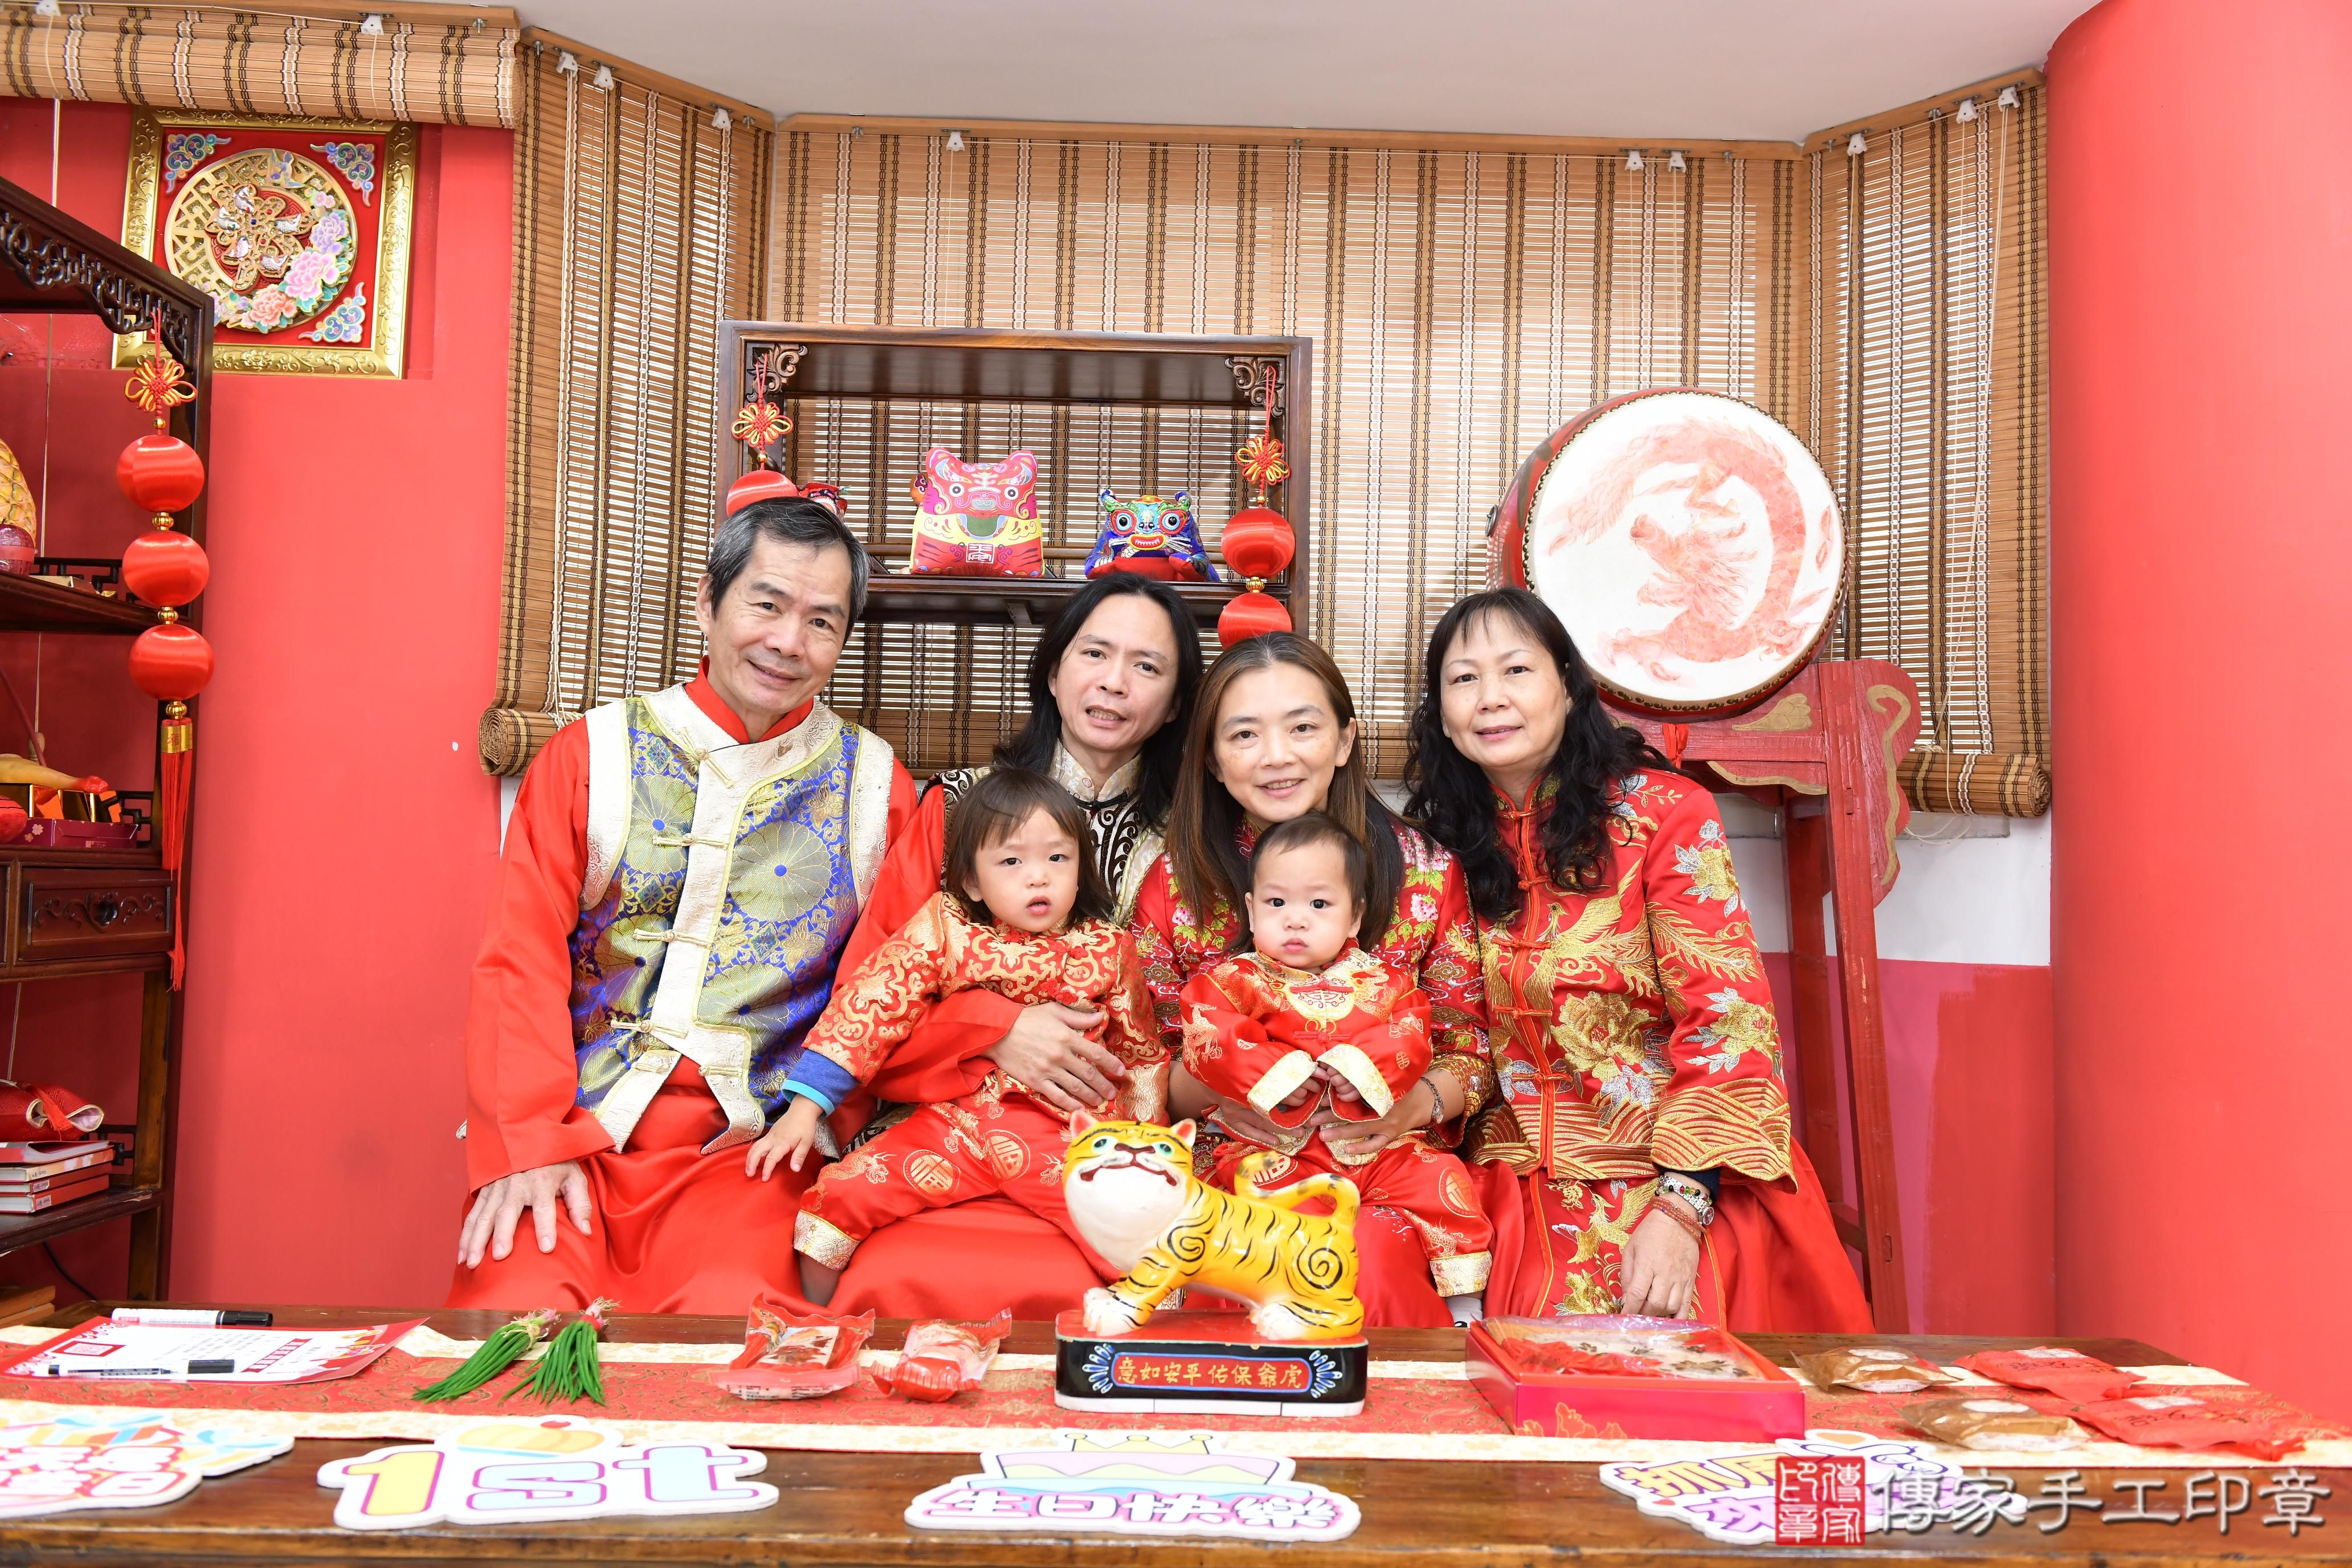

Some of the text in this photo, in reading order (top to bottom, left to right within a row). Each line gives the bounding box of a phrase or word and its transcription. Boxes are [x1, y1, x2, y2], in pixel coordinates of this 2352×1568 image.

[342, 1446, 760, 1516] 1st
[929, 1489, 1339, 1529] 生日快樂
